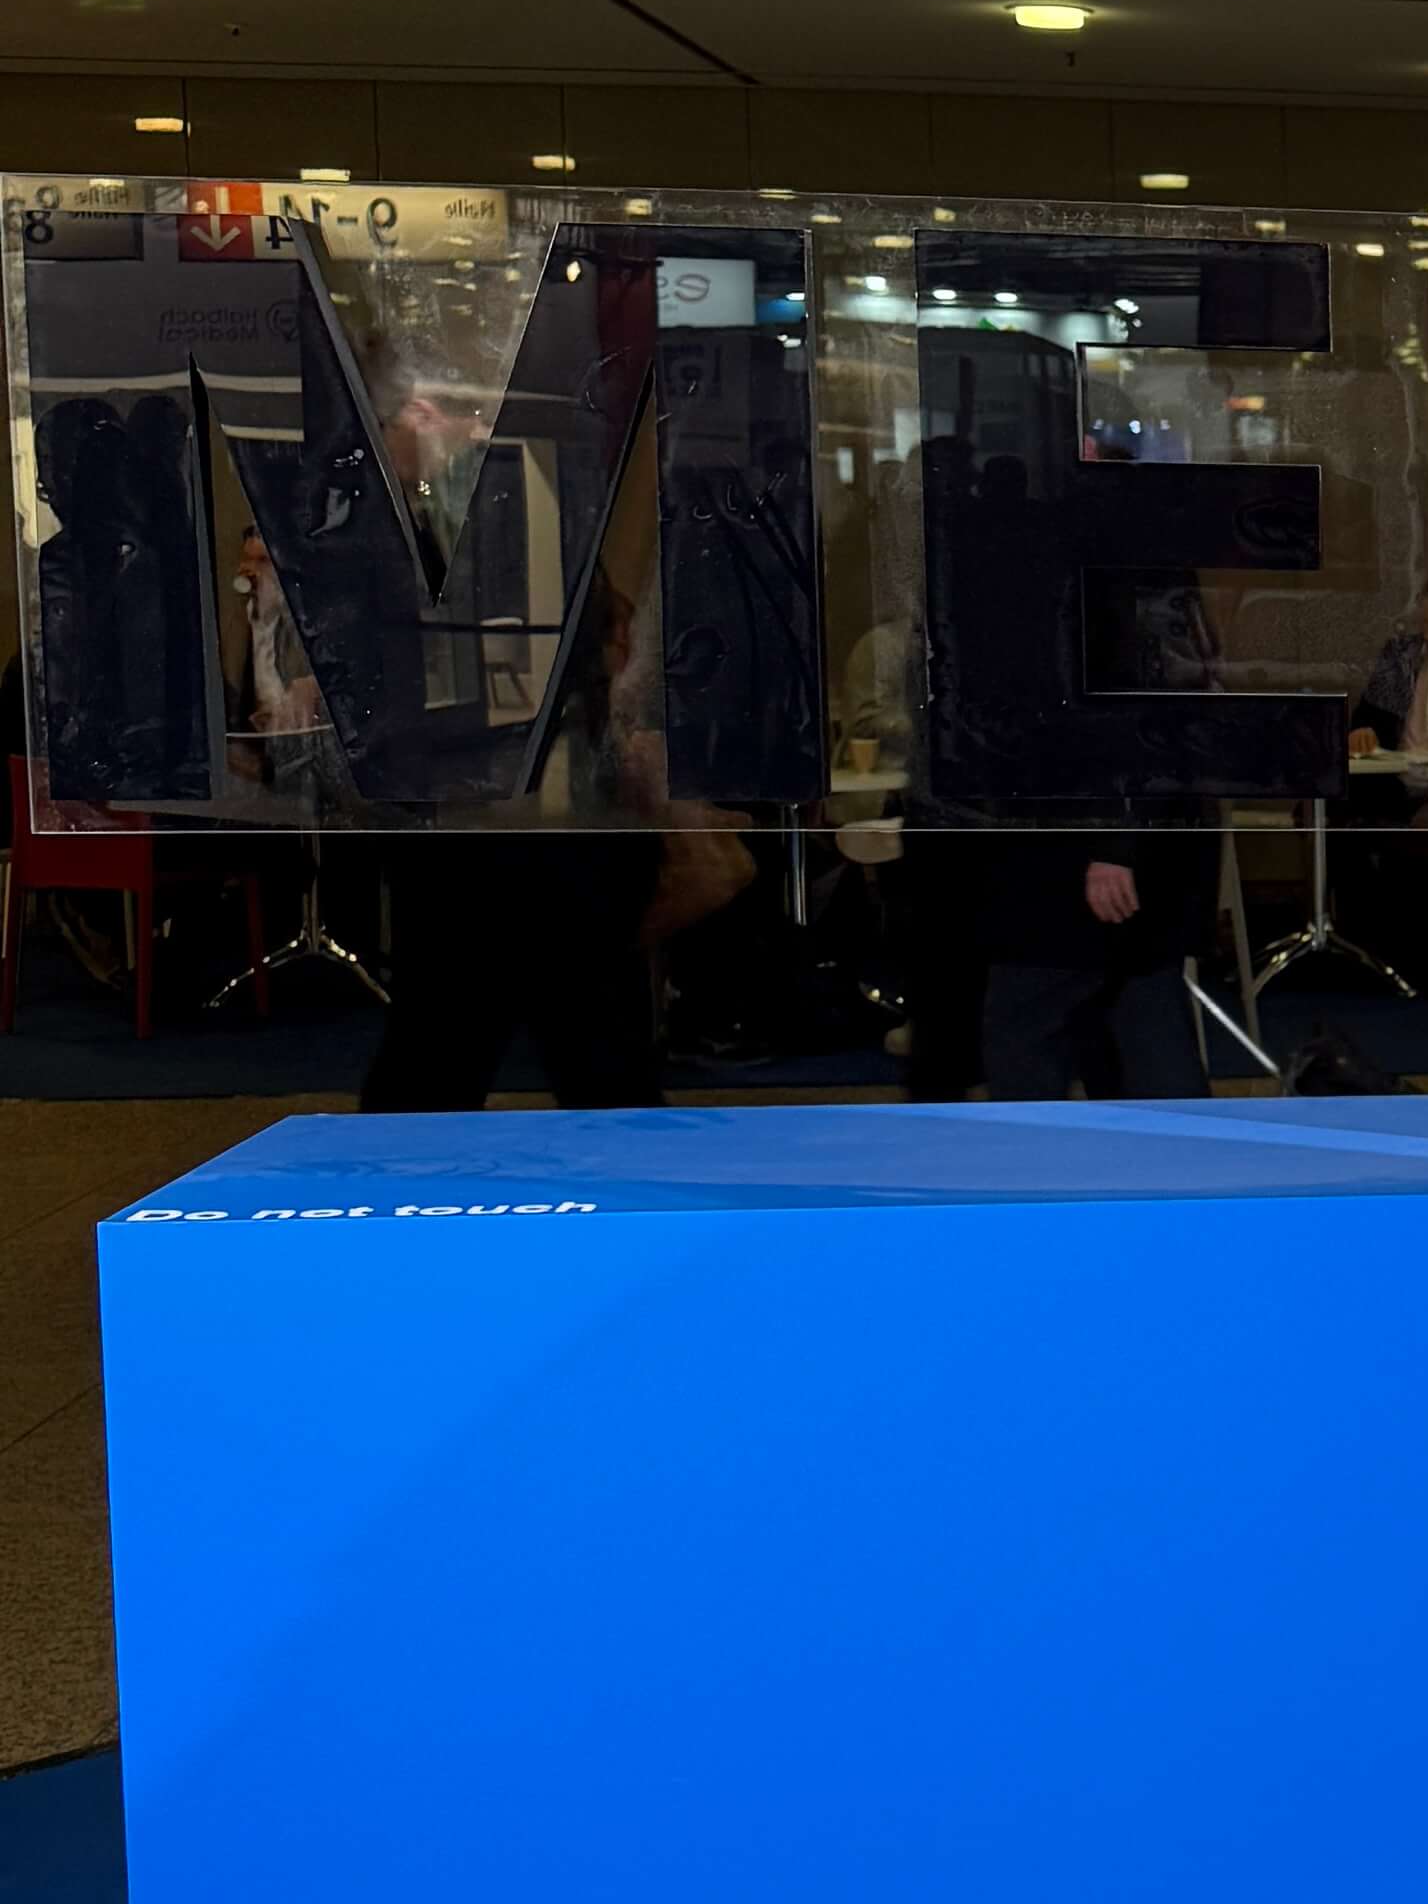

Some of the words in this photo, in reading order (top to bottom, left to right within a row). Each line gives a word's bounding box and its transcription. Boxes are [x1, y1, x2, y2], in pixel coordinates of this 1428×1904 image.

[126, 1208, 231, 1222] Do
[252, 1205, 374, 1220] not
[394, 1199, 598, 1216] touch
